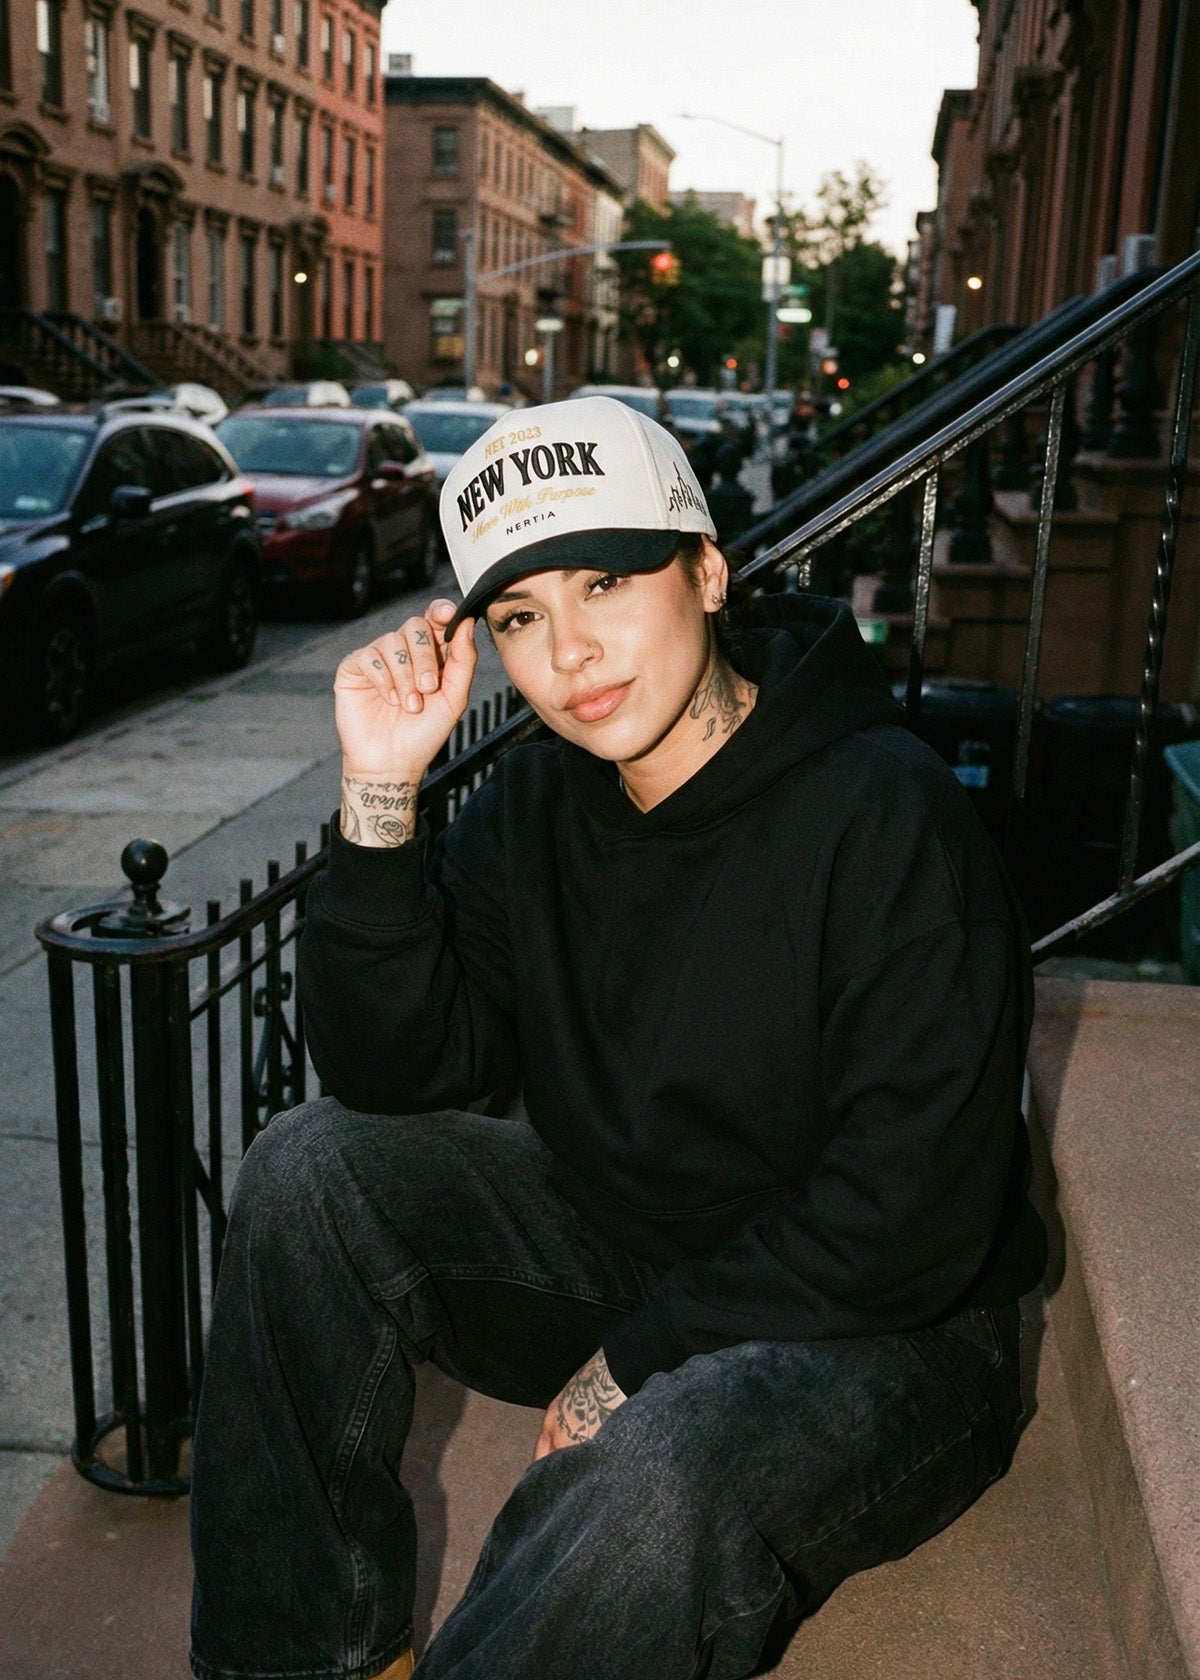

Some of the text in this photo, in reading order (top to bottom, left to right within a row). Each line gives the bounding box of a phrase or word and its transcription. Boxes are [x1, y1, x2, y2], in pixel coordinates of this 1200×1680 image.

[508, 426, 542, 445] 2023
[457, 442, 606, 532] NEW YORK
[500, 495, 533, 519] With
[536, 486, 597, 504] Purpose
[506, 511, 556, 535] NERTIA
